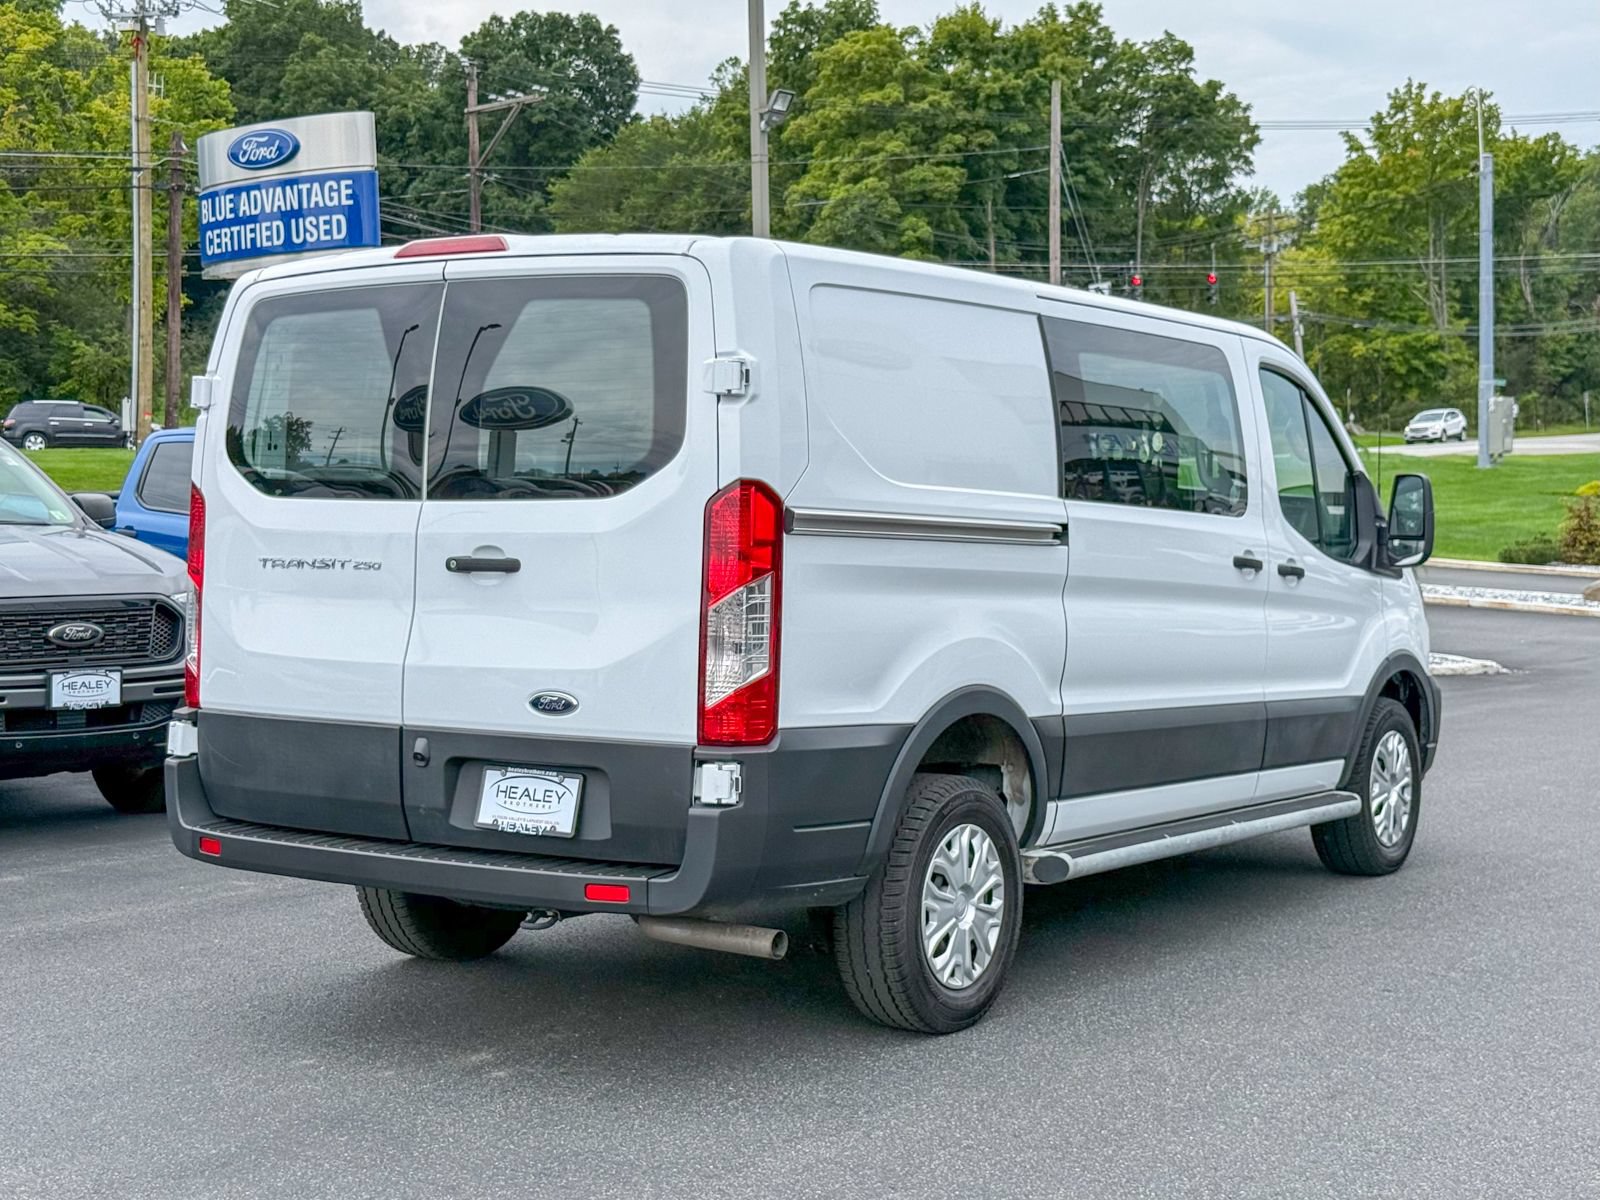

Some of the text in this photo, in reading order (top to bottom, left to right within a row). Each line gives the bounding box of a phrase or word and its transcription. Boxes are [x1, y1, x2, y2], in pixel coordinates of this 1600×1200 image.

[239, 135, 280, 163] Ford
[202, 179, 354, 225] BLUE ADVANTAGE
[205, 214, 348, 256] CERTIFIED USED
[258, 558, 382, 571] TRANSIT 250
[63, 626, 92, 640] Ford
[62, 680, 112, 691] HEALEY
[538, 696, 565, 710] Ford
[496, 784, 566, 805] HEALEY
[498, 820, 547, 836] HEALEY
